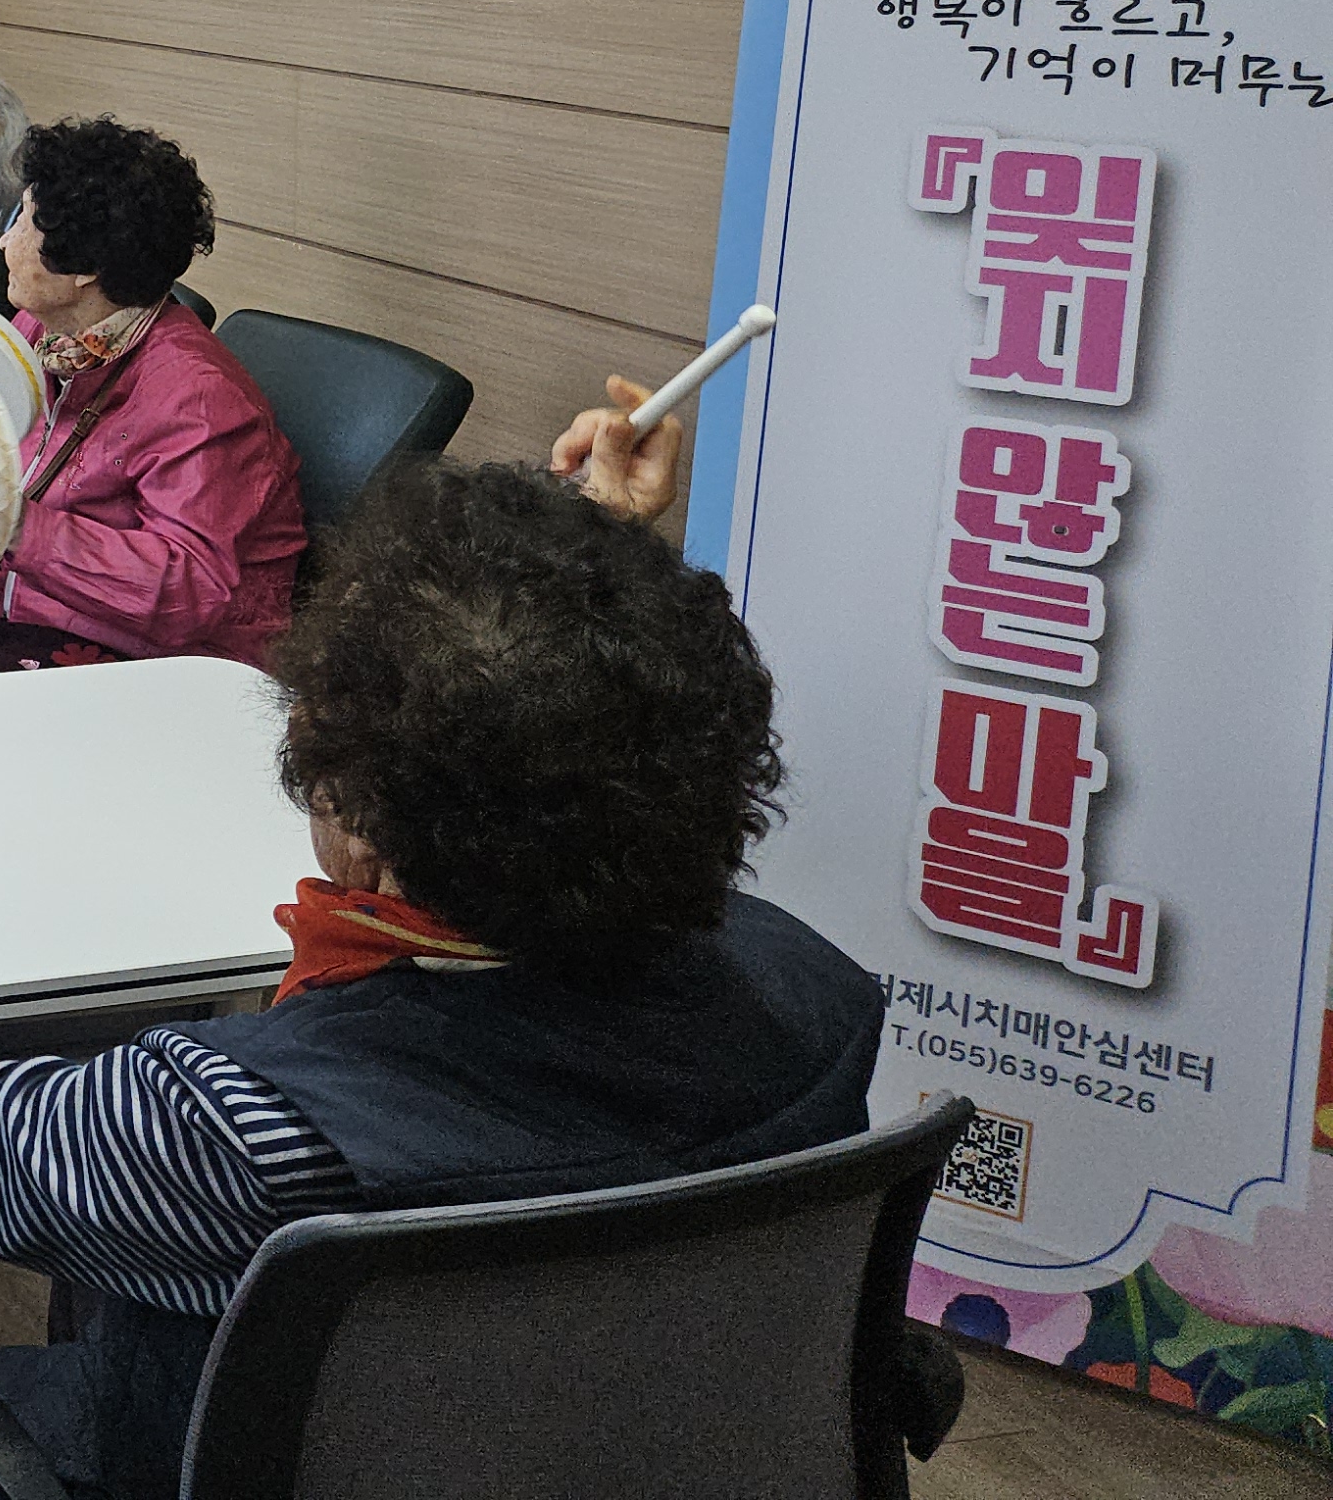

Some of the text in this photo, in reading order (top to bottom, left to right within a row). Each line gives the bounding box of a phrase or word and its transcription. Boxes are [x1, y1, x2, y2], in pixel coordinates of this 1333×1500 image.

[968, 43, 1333, 108] 기억이 머무는
[941, 424, 1117, 675] 않는
[891, 1023, 1156, 1114] T.(055)639-6226
